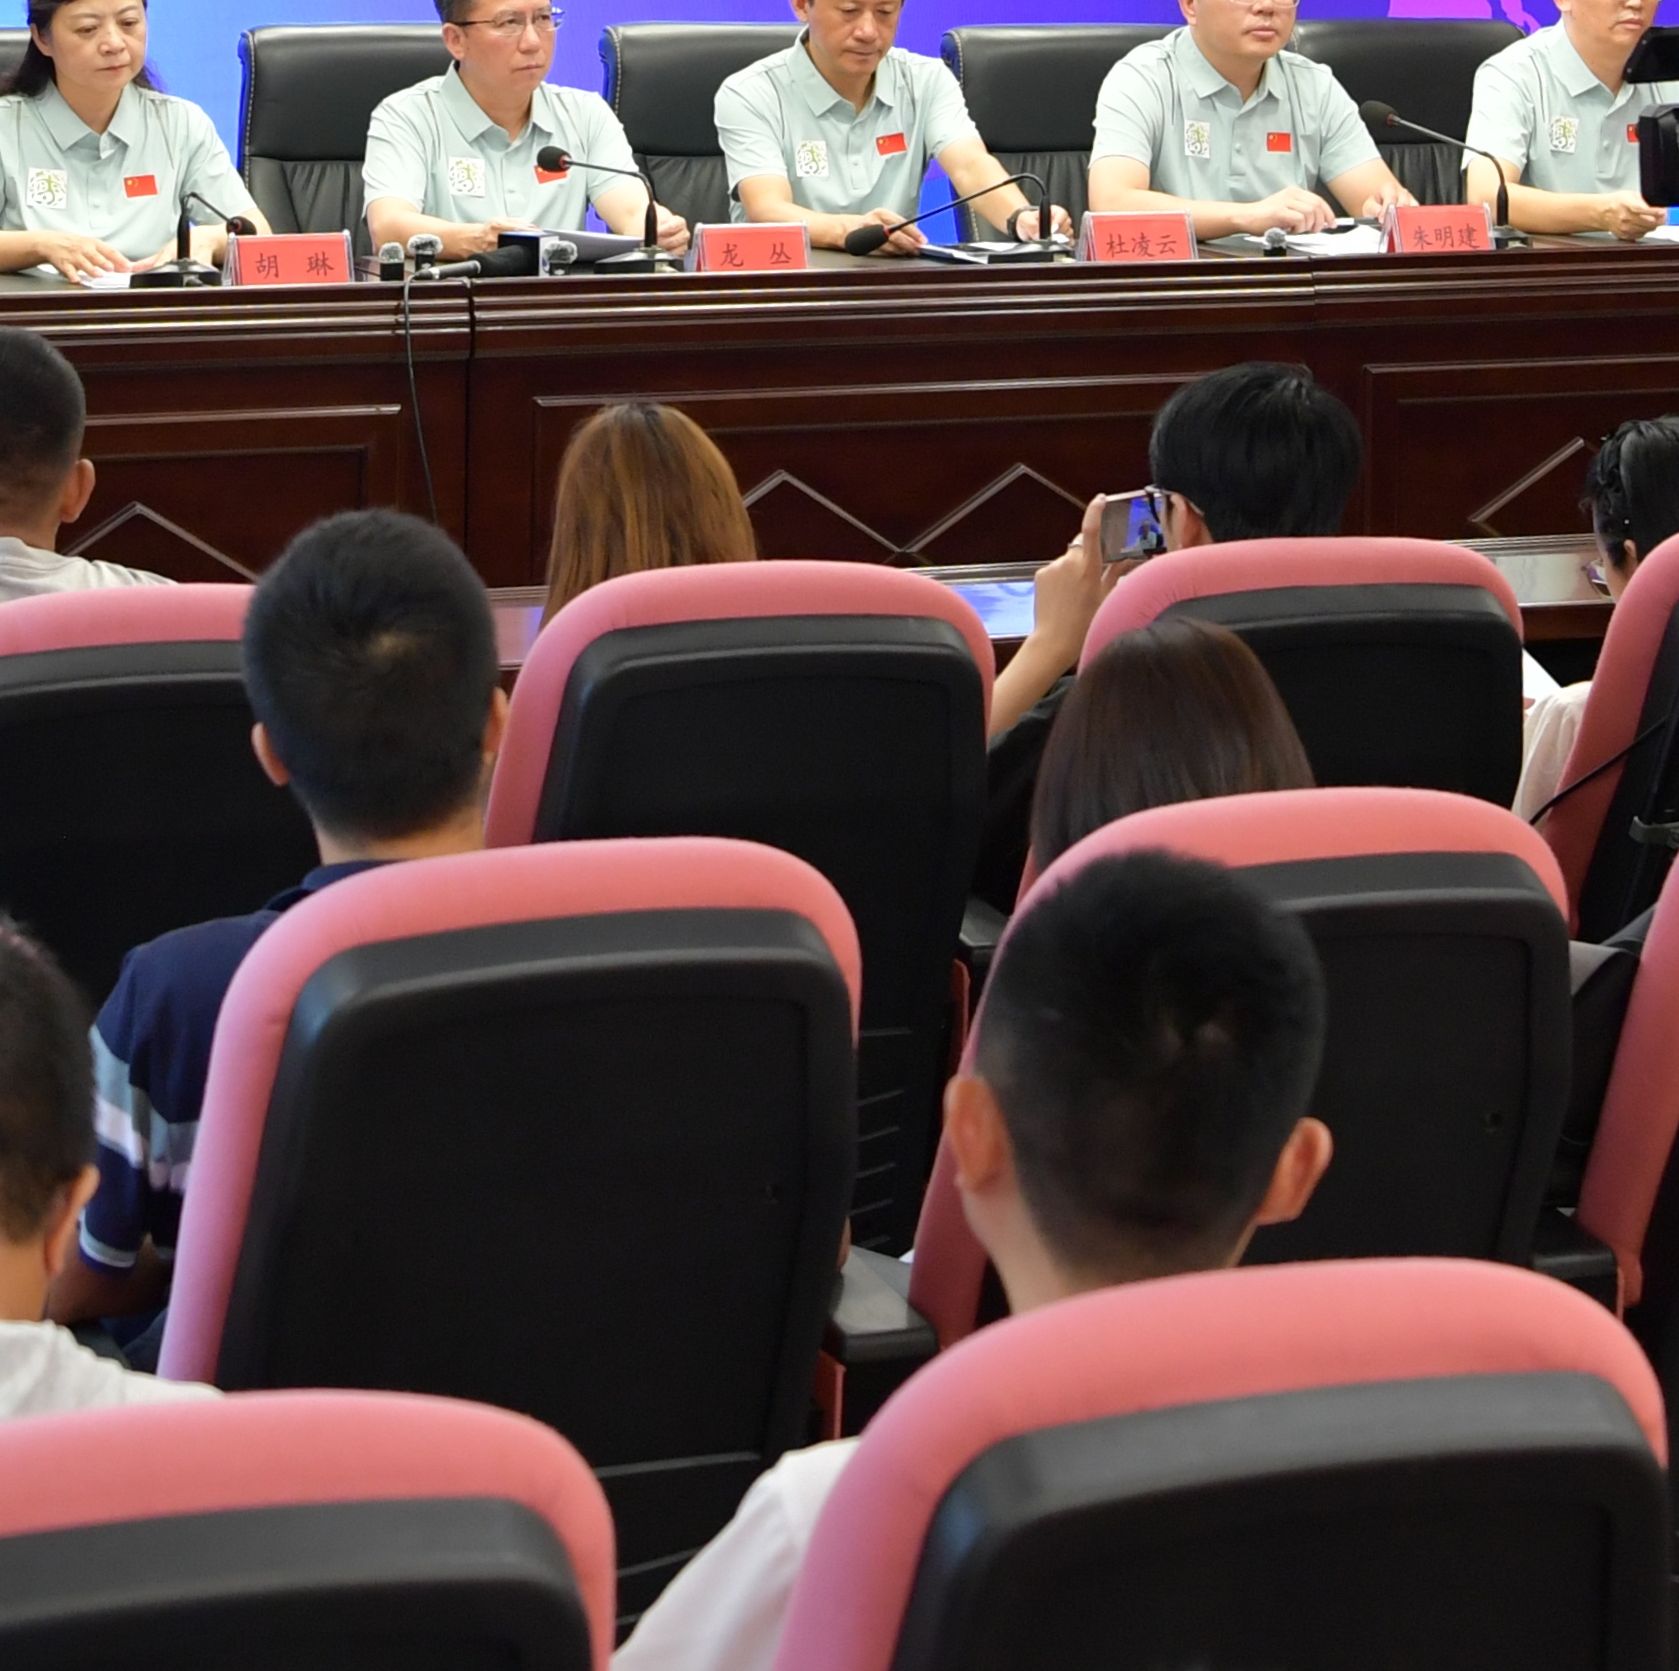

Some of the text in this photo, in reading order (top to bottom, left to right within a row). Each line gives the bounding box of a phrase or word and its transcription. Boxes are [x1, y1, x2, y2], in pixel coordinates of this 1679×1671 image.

[720, 242, 793, 268] 龙丛
[1105, 231, 1178, 259] 杜凌云
[254, 251, 336, 280] 胡琳
